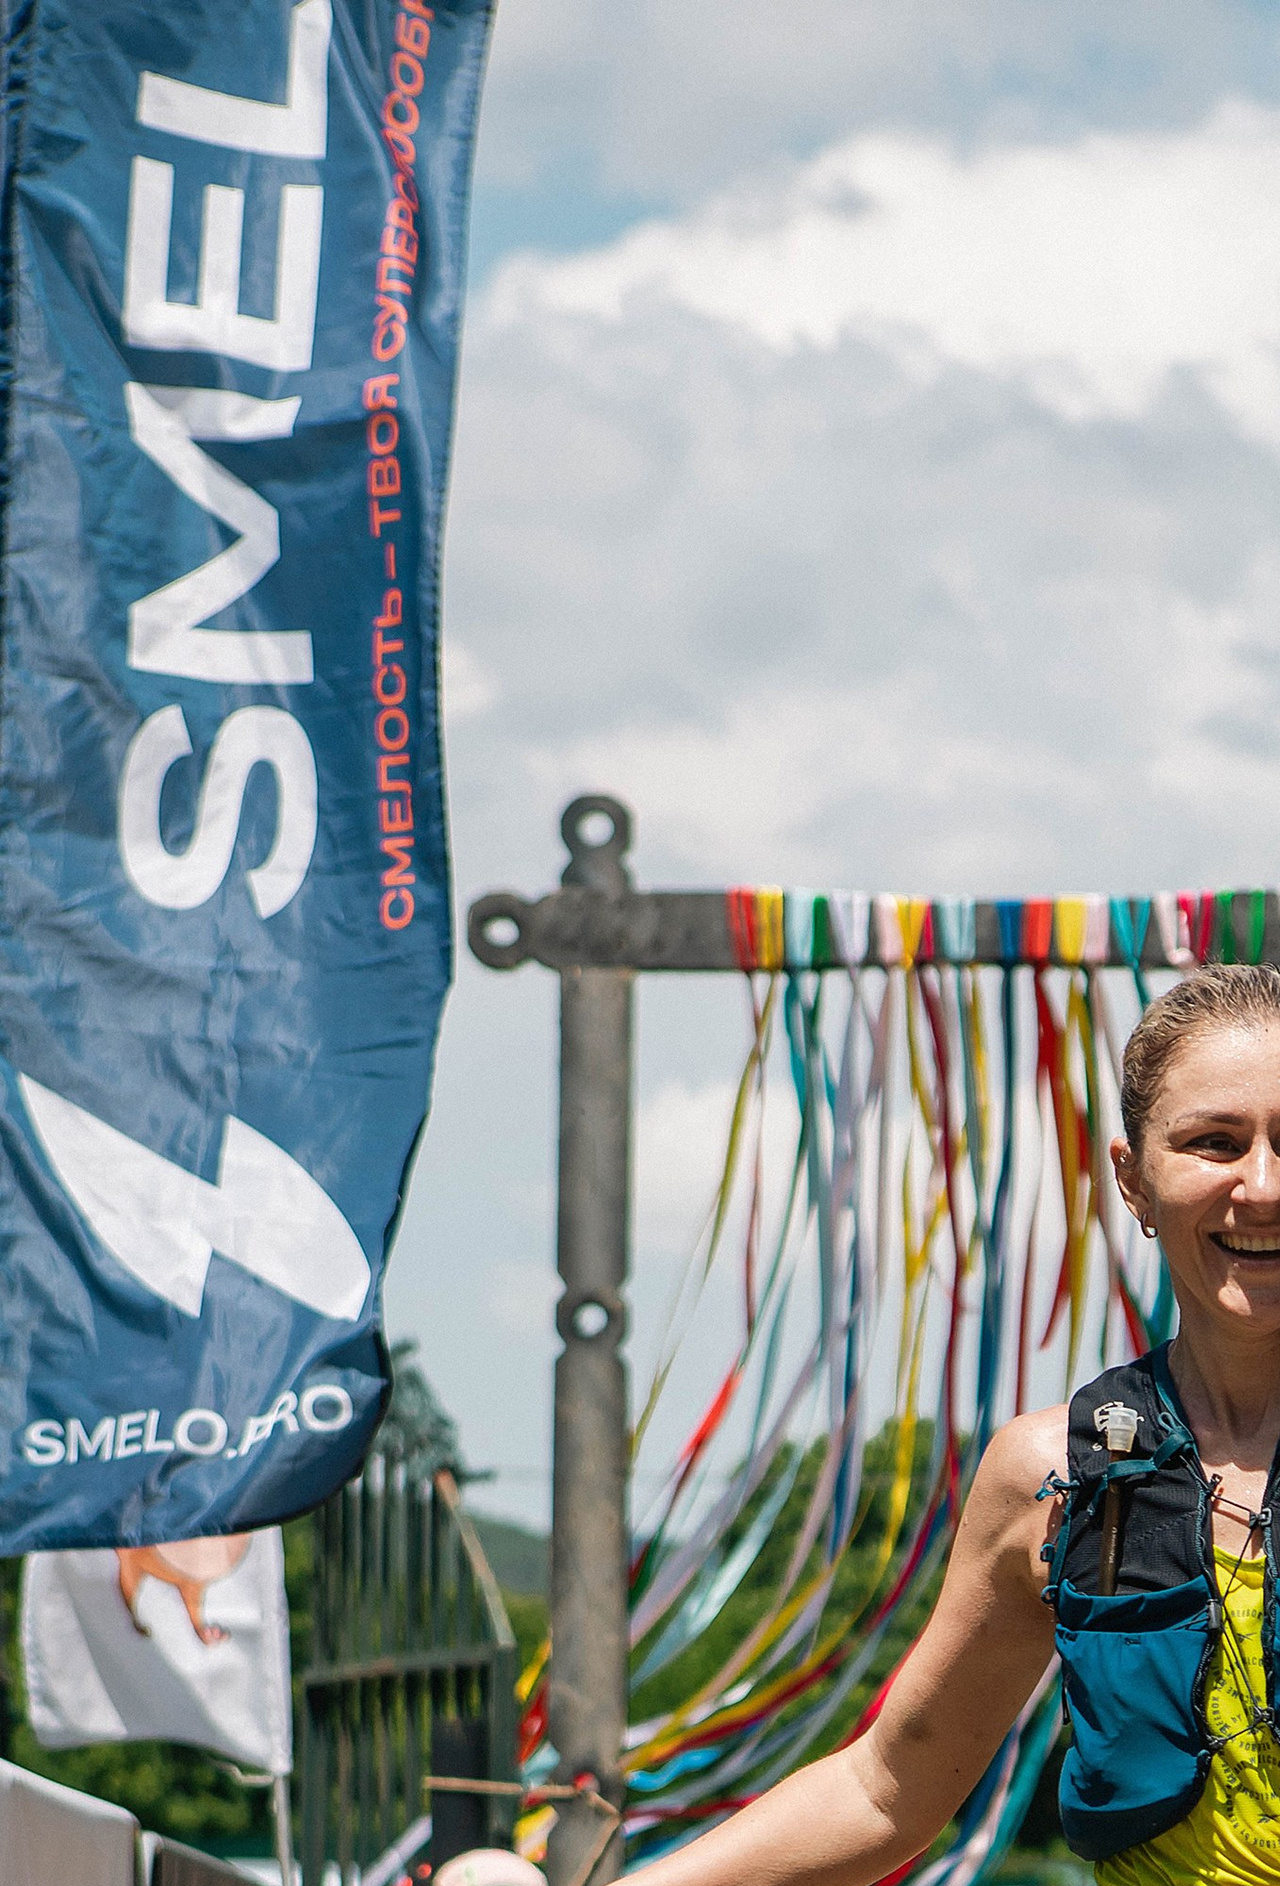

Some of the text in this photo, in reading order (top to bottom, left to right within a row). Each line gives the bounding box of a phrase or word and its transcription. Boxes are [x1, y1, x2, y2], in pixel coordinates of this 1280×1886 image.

[370, 0, 434, 361] СУПЕРСОСОБ
[121, 0, 333, 918] SMEL
[365, 374, 402, 537] ТВОЯ
[374, 588, 415, 930] СМЕЛОСТЬ
[24, 1384, 353, 1467] SMELO.PRO
